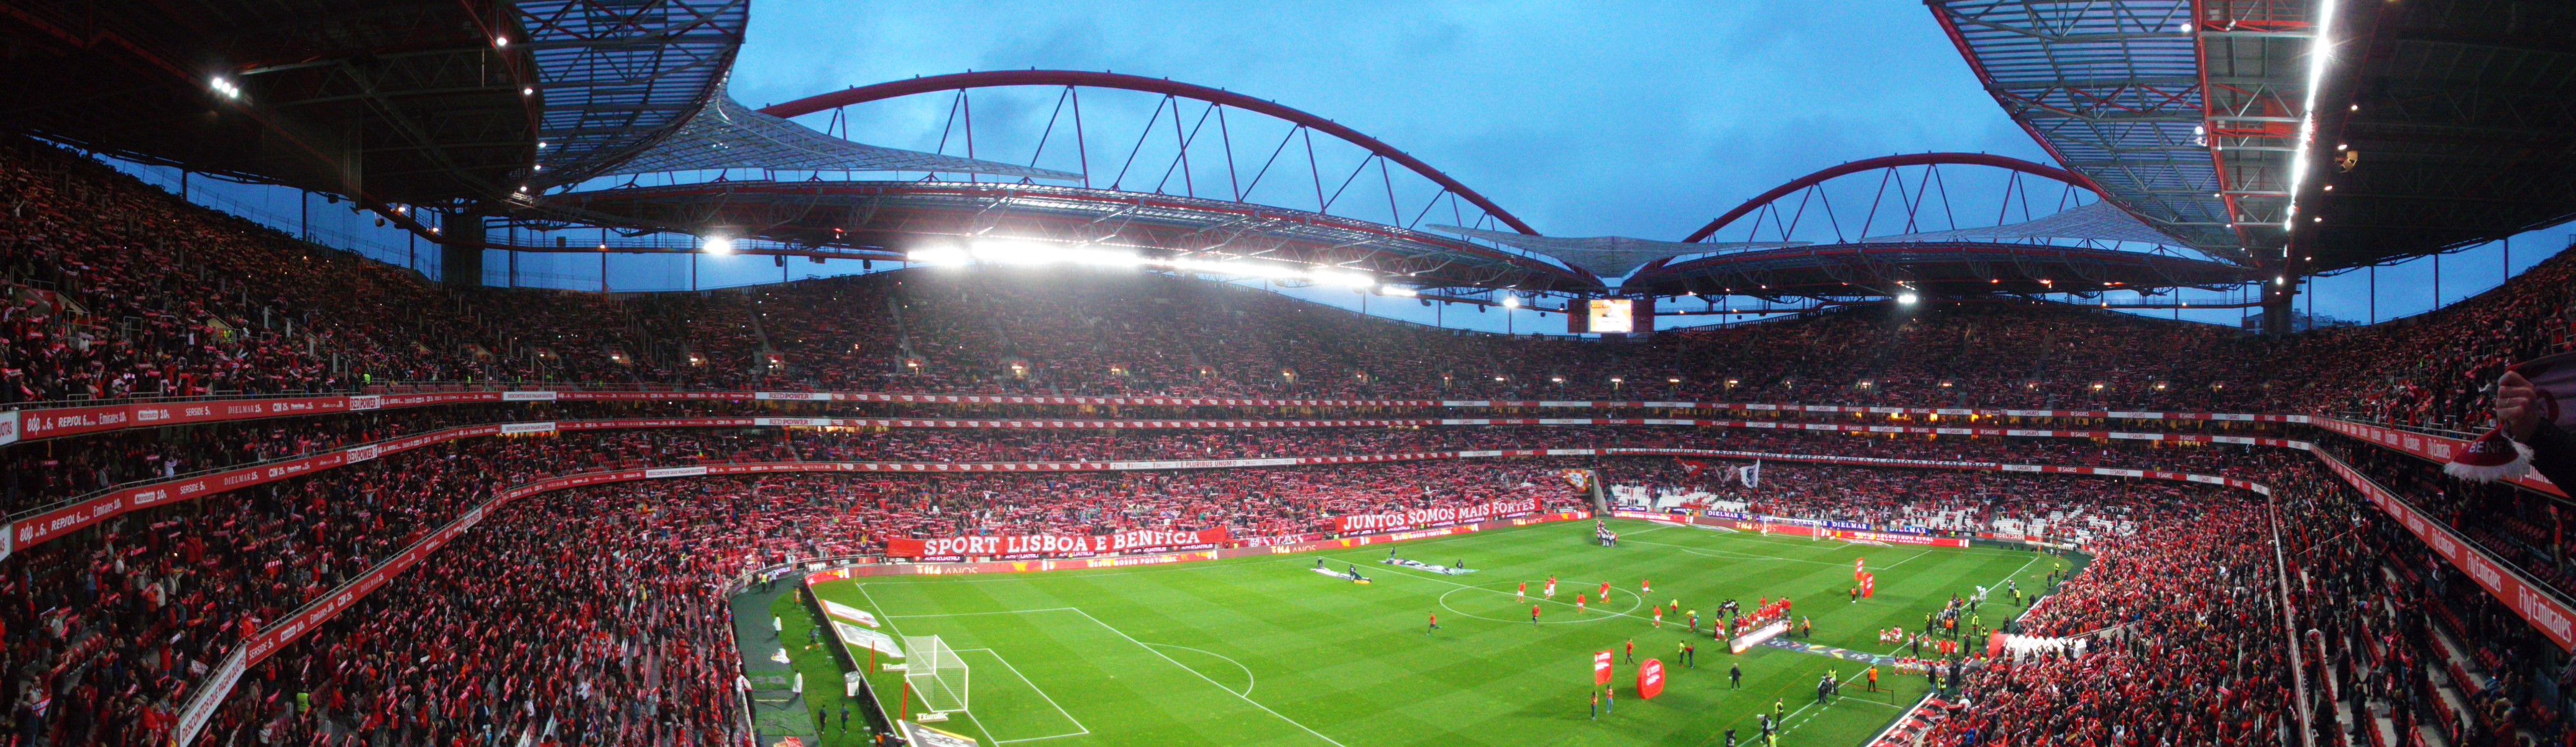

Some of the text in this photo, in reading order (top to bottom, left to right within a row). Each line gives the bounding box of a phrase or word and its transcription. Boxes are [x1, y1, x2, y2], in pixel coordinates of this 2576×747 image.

[351, 397, 377, 410] RED POWER
[58, 416, 83, 428] REPSOL
[99, 413, 119, 425] Emirates
[228, 405, 255, 414] DIELMAR
[2434, 439, 2450, 459] Emirates
[52, 515, 76, 531] REPSOL
[93, 503, 112, 518] Emirates
[224, 474, 251, 485] DIELMAR
[1344, 500, 1535, 530] JUNTOS SOMOS MAIS FORTES
[1708, 510, 1738, 518] DIELMAR
[1832, 521, 1866, 529] DIELMAR
[2411, 513, 2425, 536] Emirates
[924, 536, 999, 556] SPORT
[1007, 534, 1088, 554] LISBOA
[1095, 536, 1106, 551] E
[2438, 531, 2456, 559] Emirates
[2467, 550, 2501, 593] Fly Emirates
[249, 641, 268, 659] SEASIDE
[311, 609, 328, 624] Emirates
[360, 576, 378, 593] DIELMAR
[2519, 584, 2572, 643] Fly Emirates
[182, 654, 245, 741] DESCONTOS QUE PAGAM QUOTAS
